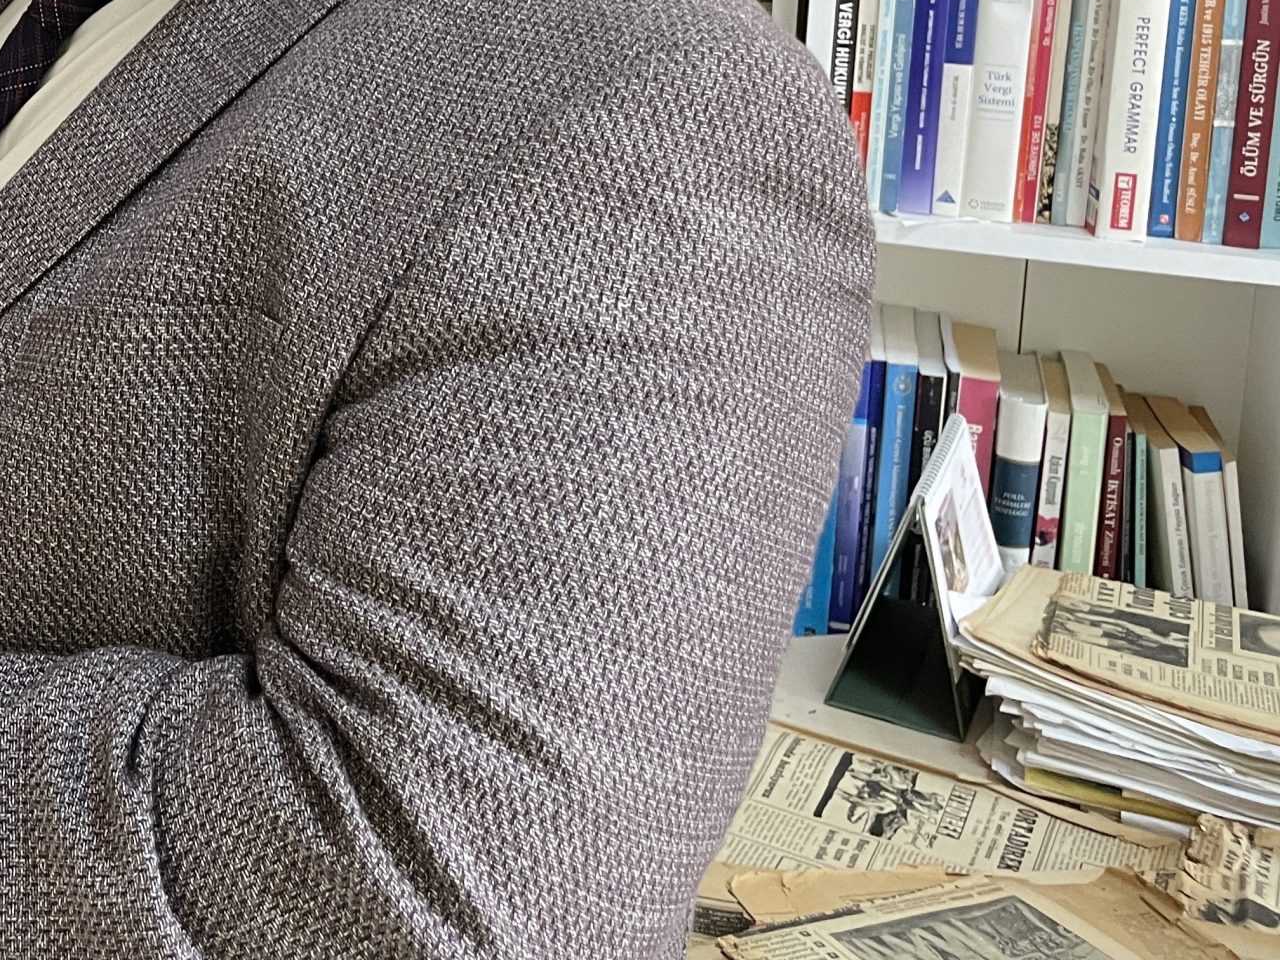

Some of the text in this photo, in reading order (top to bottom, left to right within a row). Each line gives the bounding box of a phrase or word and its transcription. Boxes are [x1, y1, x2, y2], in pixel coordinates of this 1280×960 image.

[836, 2, 854, 45] VERGİ
[1202, 23, 1212, 45] 1915
[1131, 16, 1151, 76] PERFECT
[984, 84, 1013, 97] Vergi
[986, 70, 1013, 82] Türk
[978, 95, 1015, 107] Sistemi
[1122, 81, 1144, 155] GRAMMAR
[1193, 86, 1205, 121] OLAYI
[1239, 39, 1272, 178] ÖLÜM VE SÜRGÜN
[1118, 189, 1133, 228] TEOREM
[1103, 437, 1124, 529] Osmanlı İKTİSAT
